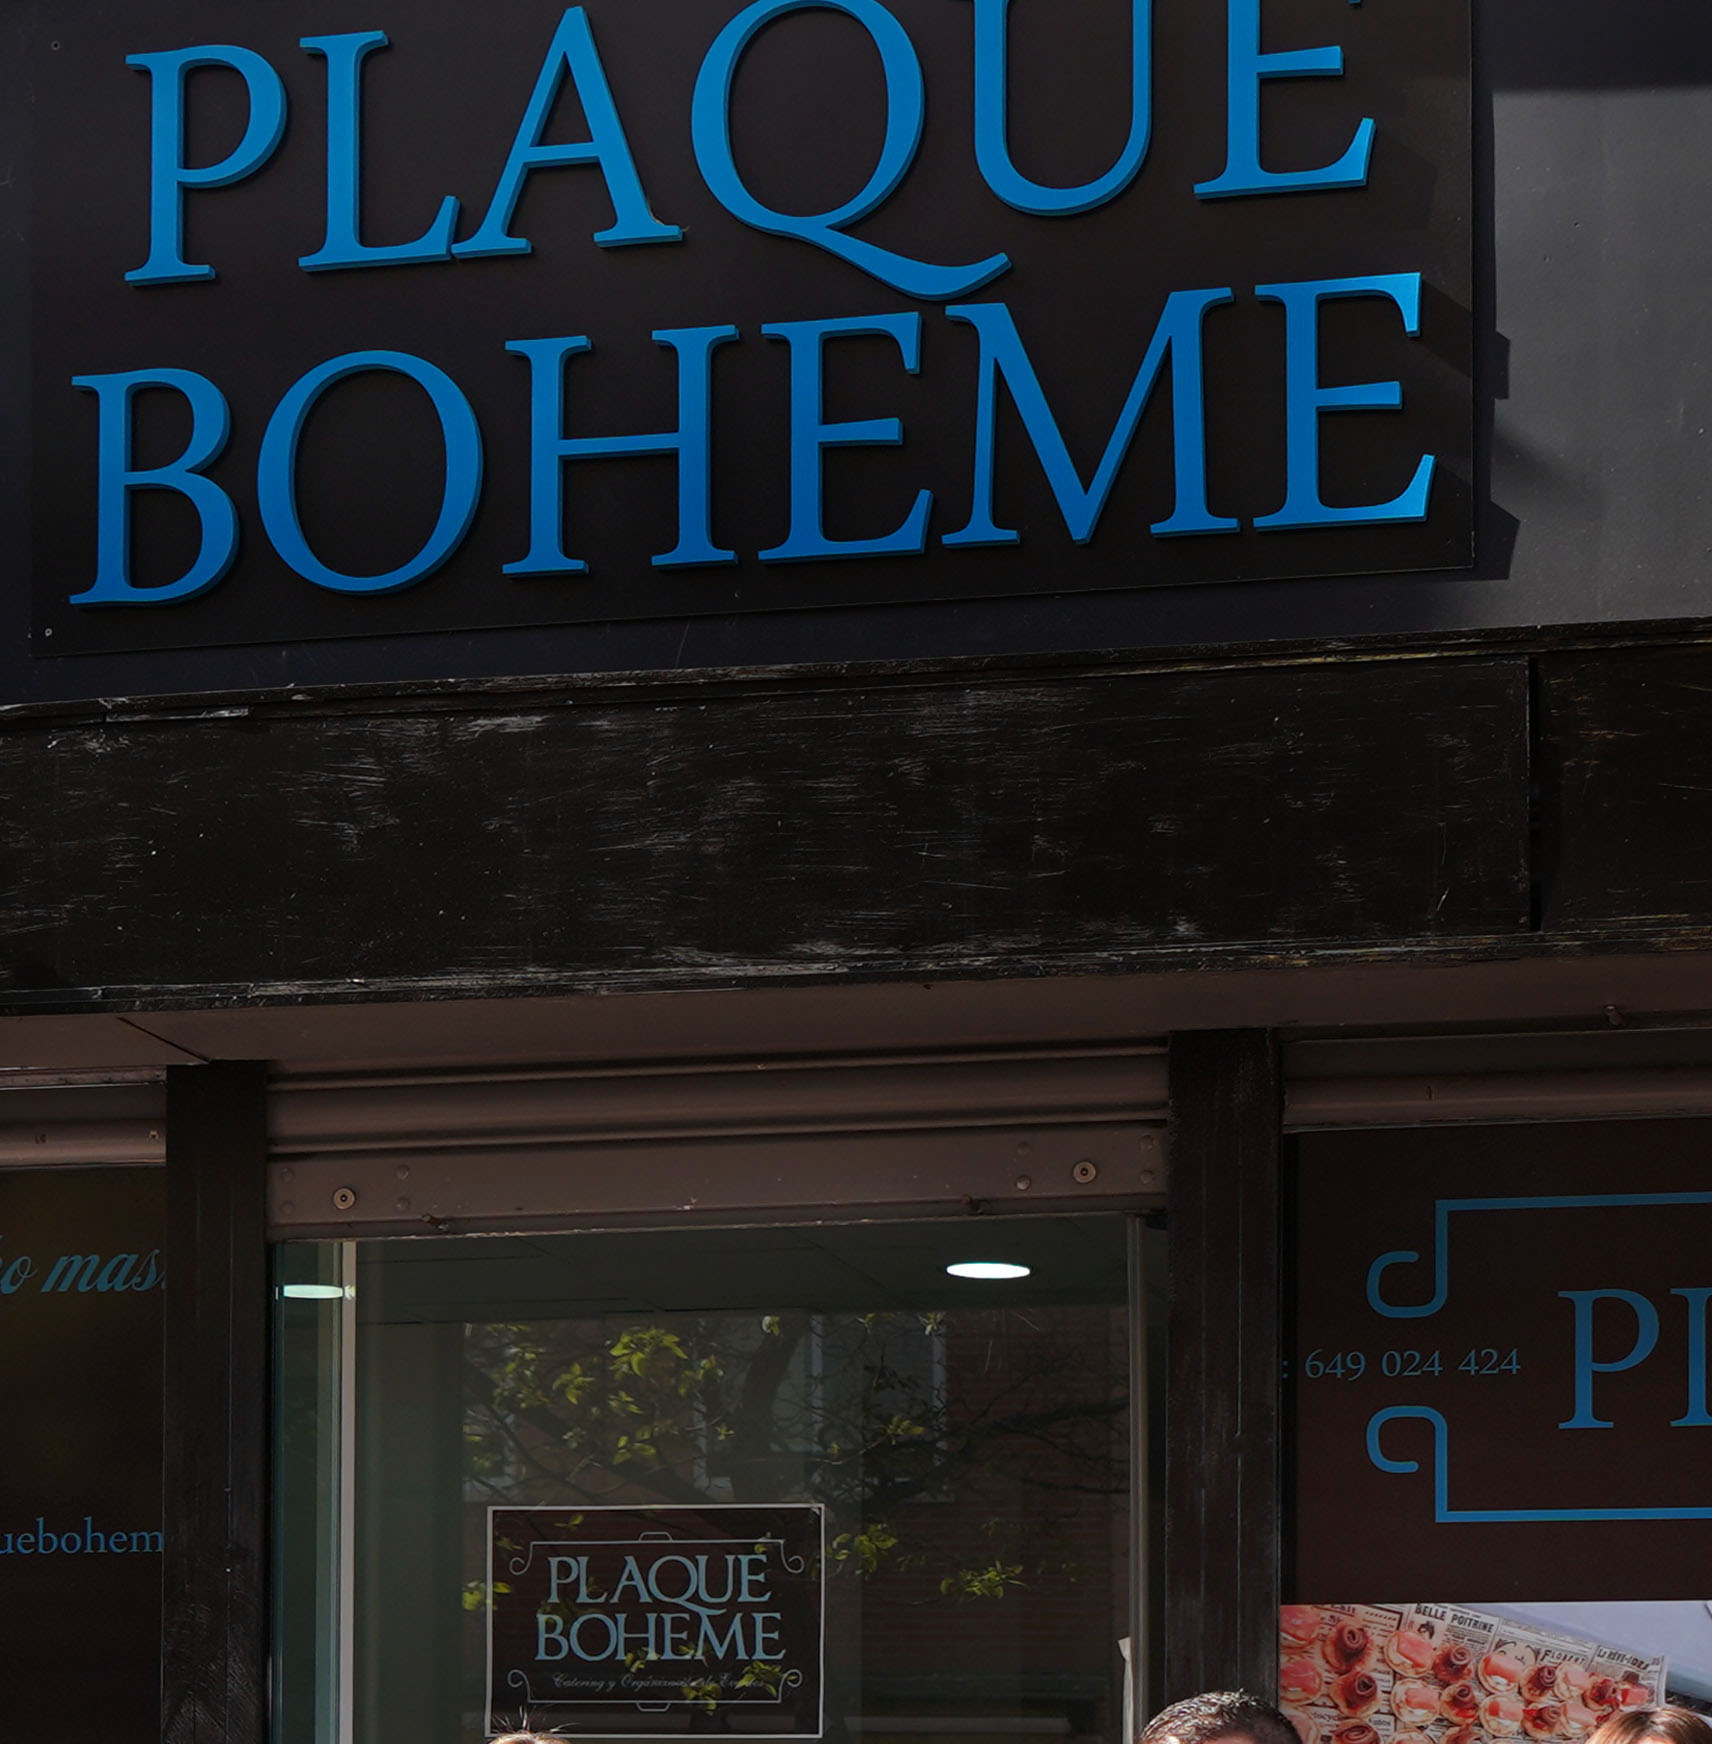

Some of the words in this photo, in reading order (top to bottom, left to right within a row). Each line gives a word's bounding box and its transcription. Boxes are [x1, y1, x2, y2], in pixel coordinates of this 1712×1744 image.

[124, 0, 1375, 299] PLAQUE
[69, 272, 1436, 604] BOHEME
[1305, 1349, 1367, 1381] 649
[1381, 1349, 1444, 1377] 024
[1458, 1348, 1521, 1376] 424
[546, 1554, 772, 1617] PLAQUE
[534, 1611, 787, 1662] BOHEME
[1415, 1603, 1447, 1622] BELLE
[1451, 1614, 1495, 1633] POITRINE
